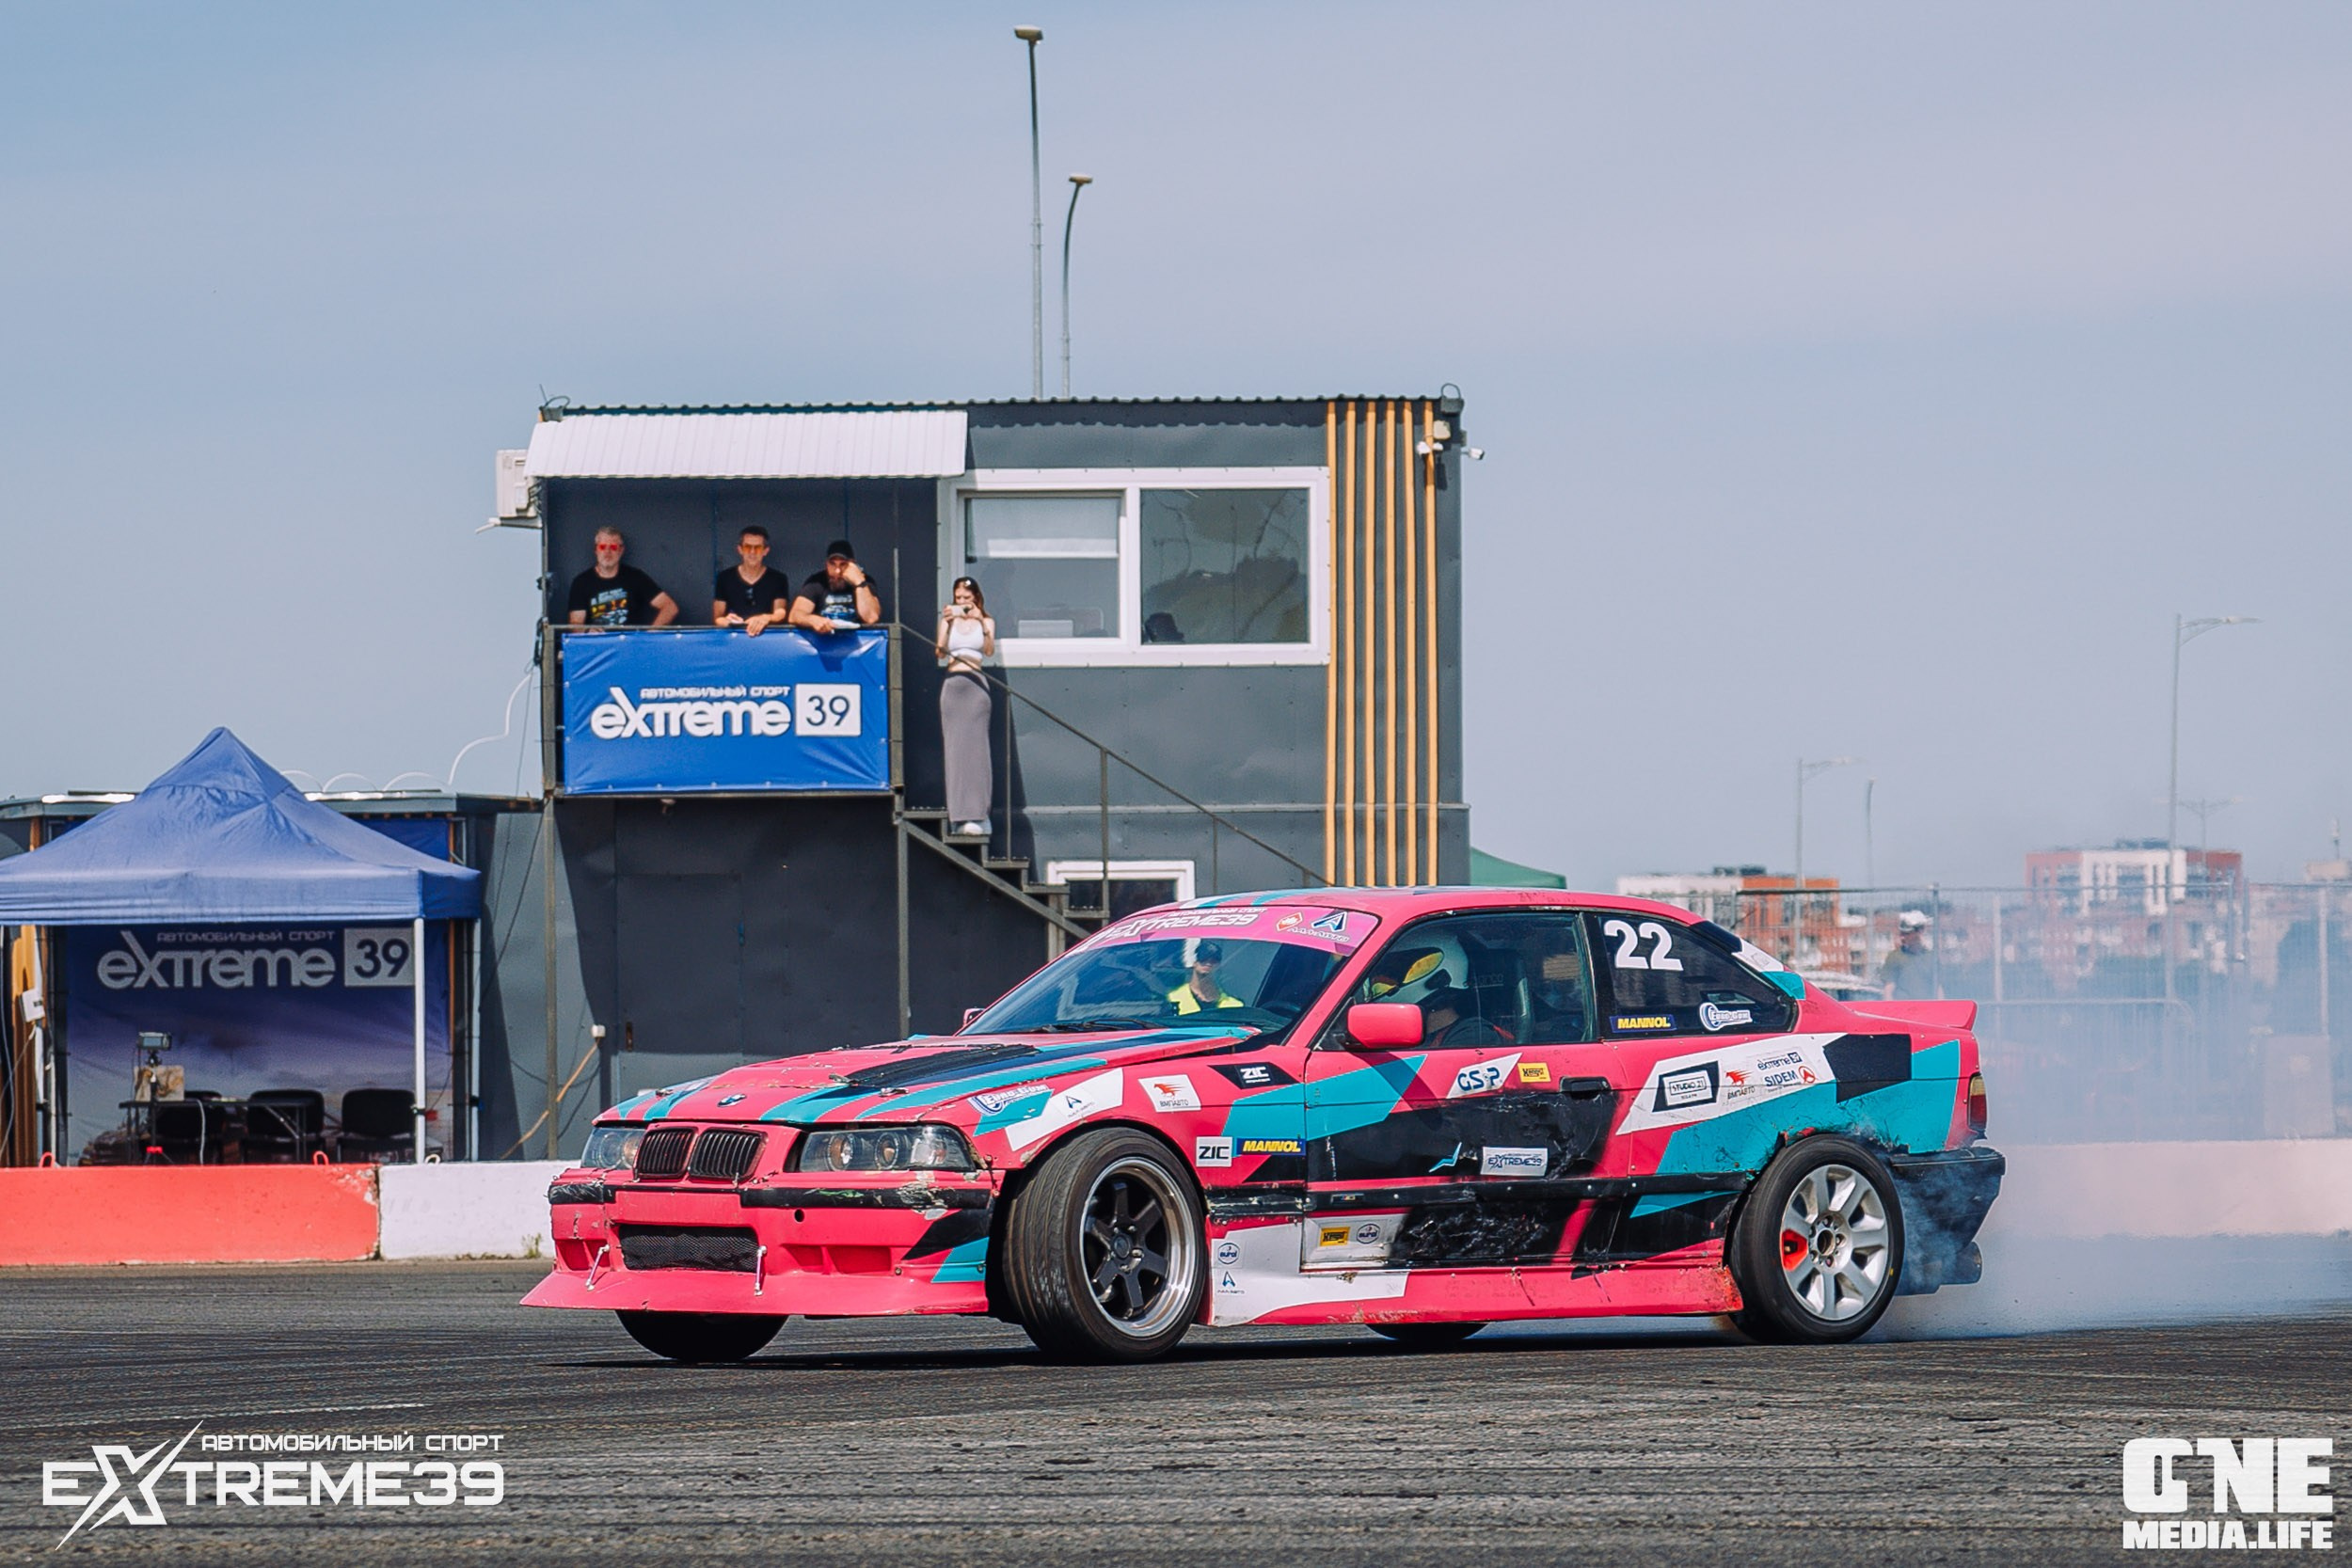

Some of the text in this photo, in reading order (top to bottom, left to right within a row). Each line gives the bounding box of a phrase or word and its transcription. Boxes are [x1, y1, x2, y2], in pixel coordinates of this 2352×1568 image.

[640, 685, 791, 700] АВТОМОБИЛЬНЫЙ СПОРТ
[805, 694, 851, 727] 39
[156, 929, 336, 942] АВТОМОБИЛЬНЫЙ СПОРТ
[1603, 919, 1684, 972] 22
[353, 938, 411, 980] 39
[1617, 1016, 1671, 1030] MANNOL
[1240, 1066, 1269, 1080] ZIC
[1457, 1067, 1501, 1091] GSP
[1764, 1069, 1799, 1087] SIDEM
[1199, 1146, 1230, 1160] ZIC
[1242, 1140, 1301, 1153] MANNOL
